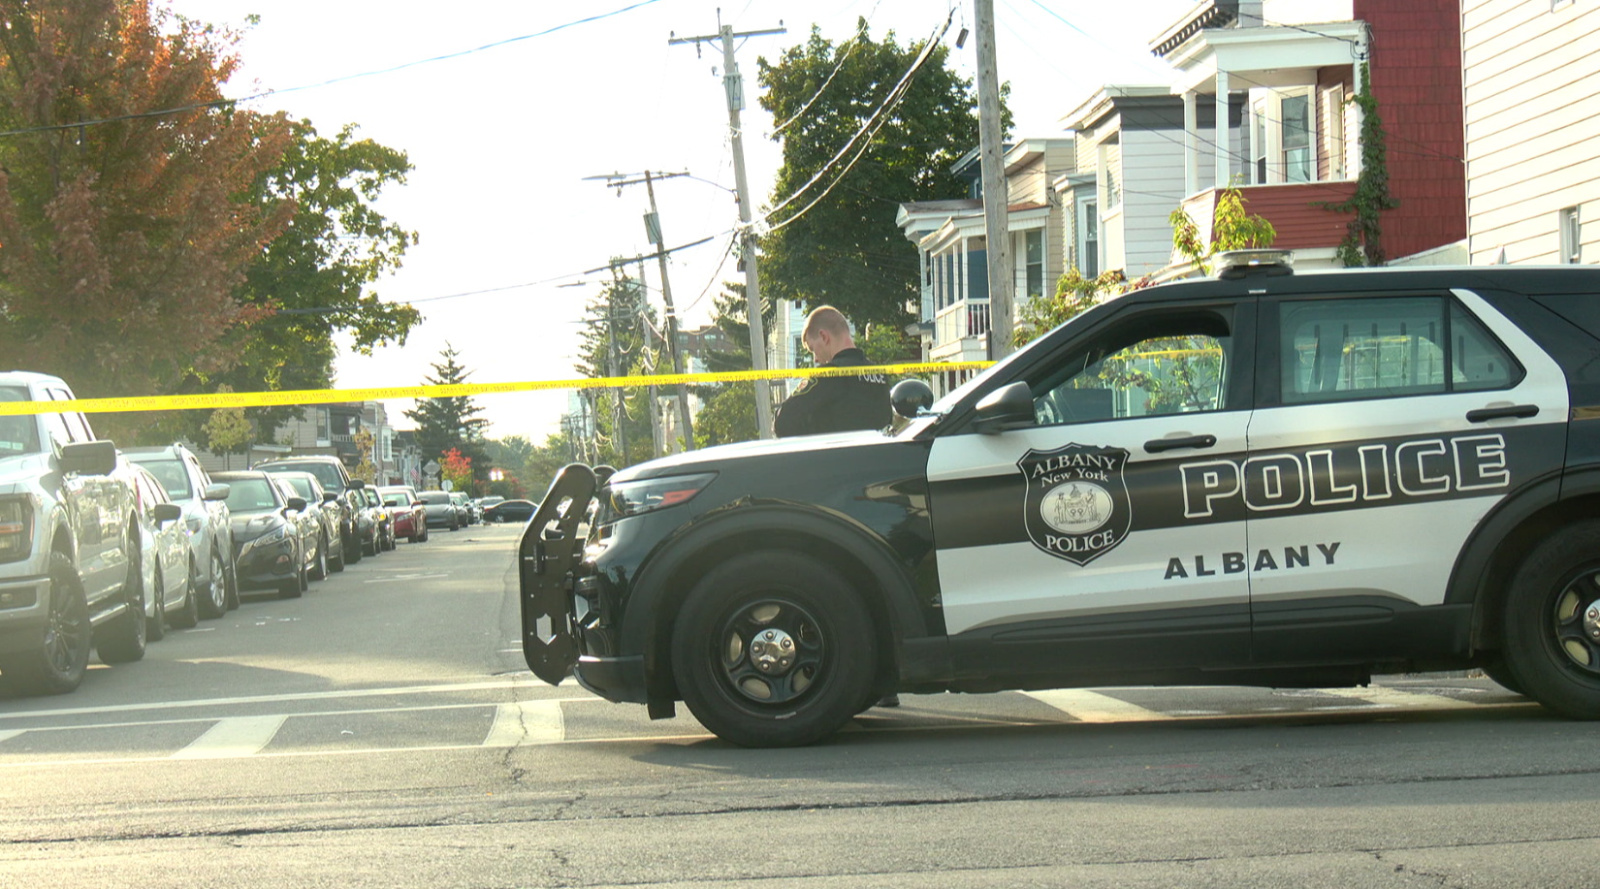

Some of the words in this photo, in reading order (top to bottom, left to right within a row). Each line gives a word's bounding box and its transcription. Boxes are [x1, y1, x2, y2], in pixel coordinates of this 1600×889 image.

[1031, 453, 1116, 479] ALBANY
[1041, 471, 1072, 488] New
[1075, 468, 1109, 482] York
[1179, 434, 1510, 519] POLICE
[1045, 529, 1115, 552] POLICE
[1163, 542, 1342, 580] ALBANY
